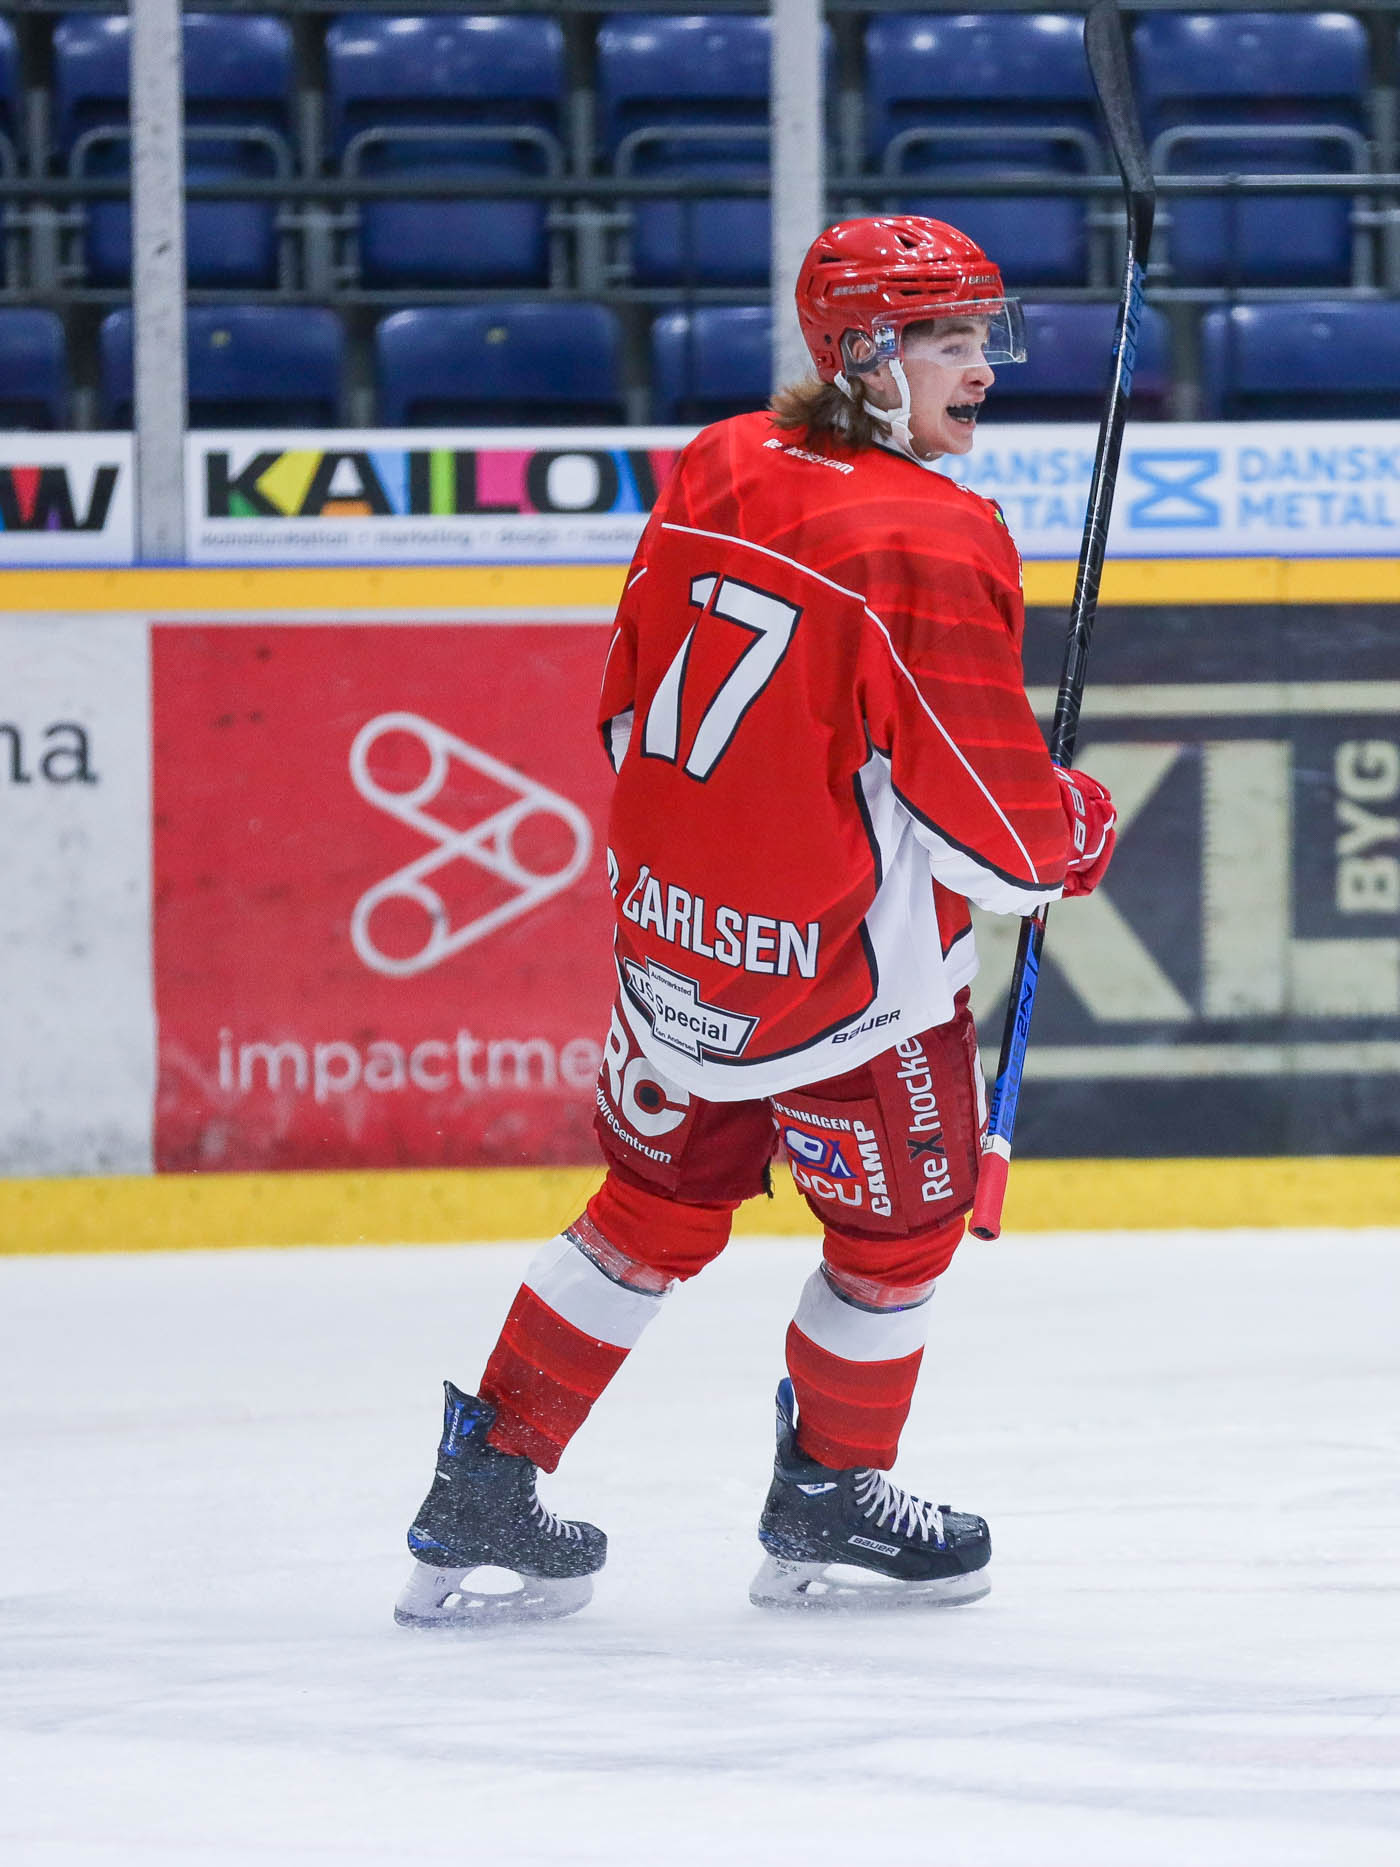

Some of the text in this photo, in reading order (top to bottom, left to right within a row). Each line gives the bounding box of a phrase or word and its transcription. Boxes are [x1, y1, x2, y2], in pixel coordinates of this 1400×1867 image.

[1236, 491, 1395, 530] METAL
[640, 571, 803, 784] 17
[621, 864, 820, 979] CARLSEN
[853, 1120, 892, 1217] CAMP
